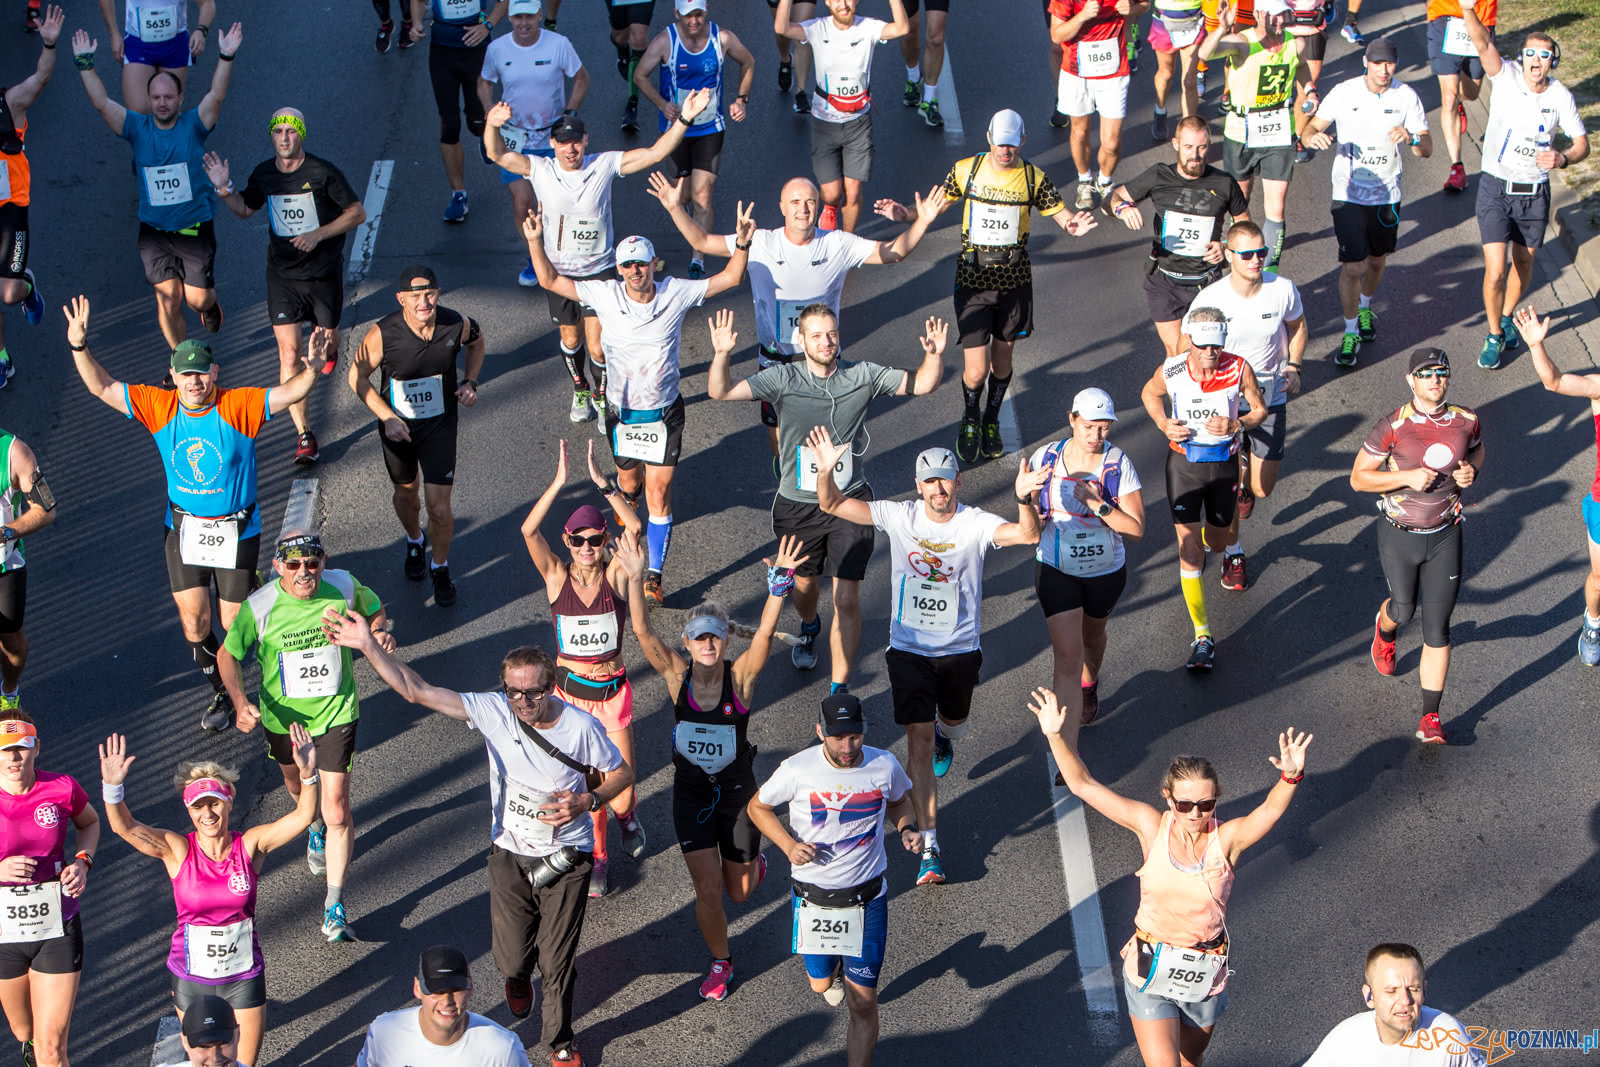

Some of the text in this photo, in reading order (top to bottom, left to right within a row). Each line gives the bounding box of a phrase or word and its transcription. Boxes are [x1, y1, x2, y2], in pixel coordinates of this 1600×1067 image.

[146, 18, 171, 29] 5635
[1088, 52, 1112, 62] 1868
[836, 85, 859, 96] 1061
[1258, 123, 1281, 134] 1573
[504, 136, 517, 149] 38
[1514, 146, 1536, 158] 402
[1361, 155, 1388, 166] 4475
[154, 178, 180, 190] 1710
[282, 209, 304, 220] 700
[981, 218, 1009, 230] 3216
[572, 230, 599, 240] 1622
[1178, 228, 1200, 241] 735
[13, 231, 22, 262] INGRESS
[788, 316, 800, 328] 10
[404, 391, 433, 404] 4118
[1186, 408, 1220, 420] 1096
[625, 431, 659, 444] 5420
[811, 460, 844, 474] 50
[198, 534, 225, 548] 289
[1069, 544, 1104, 558] 3253
[912, 596, 947, 612] 1620
[282, 626, 323, 640] NOWOTOM
[570, 632, 609, 646] 4840
[283, 640, 303, 648] KLUB
[304, 633, 327, 644] BIEGA
[299, 664, 329, 679] 286
[688, 740, 722, 756] 5701
[6, 902, 50, 919] 3838
[812, 918, 848, 934] 2361
[206, 942, 238, 958] 554
[1167, 967, 1206, 984] 1505
